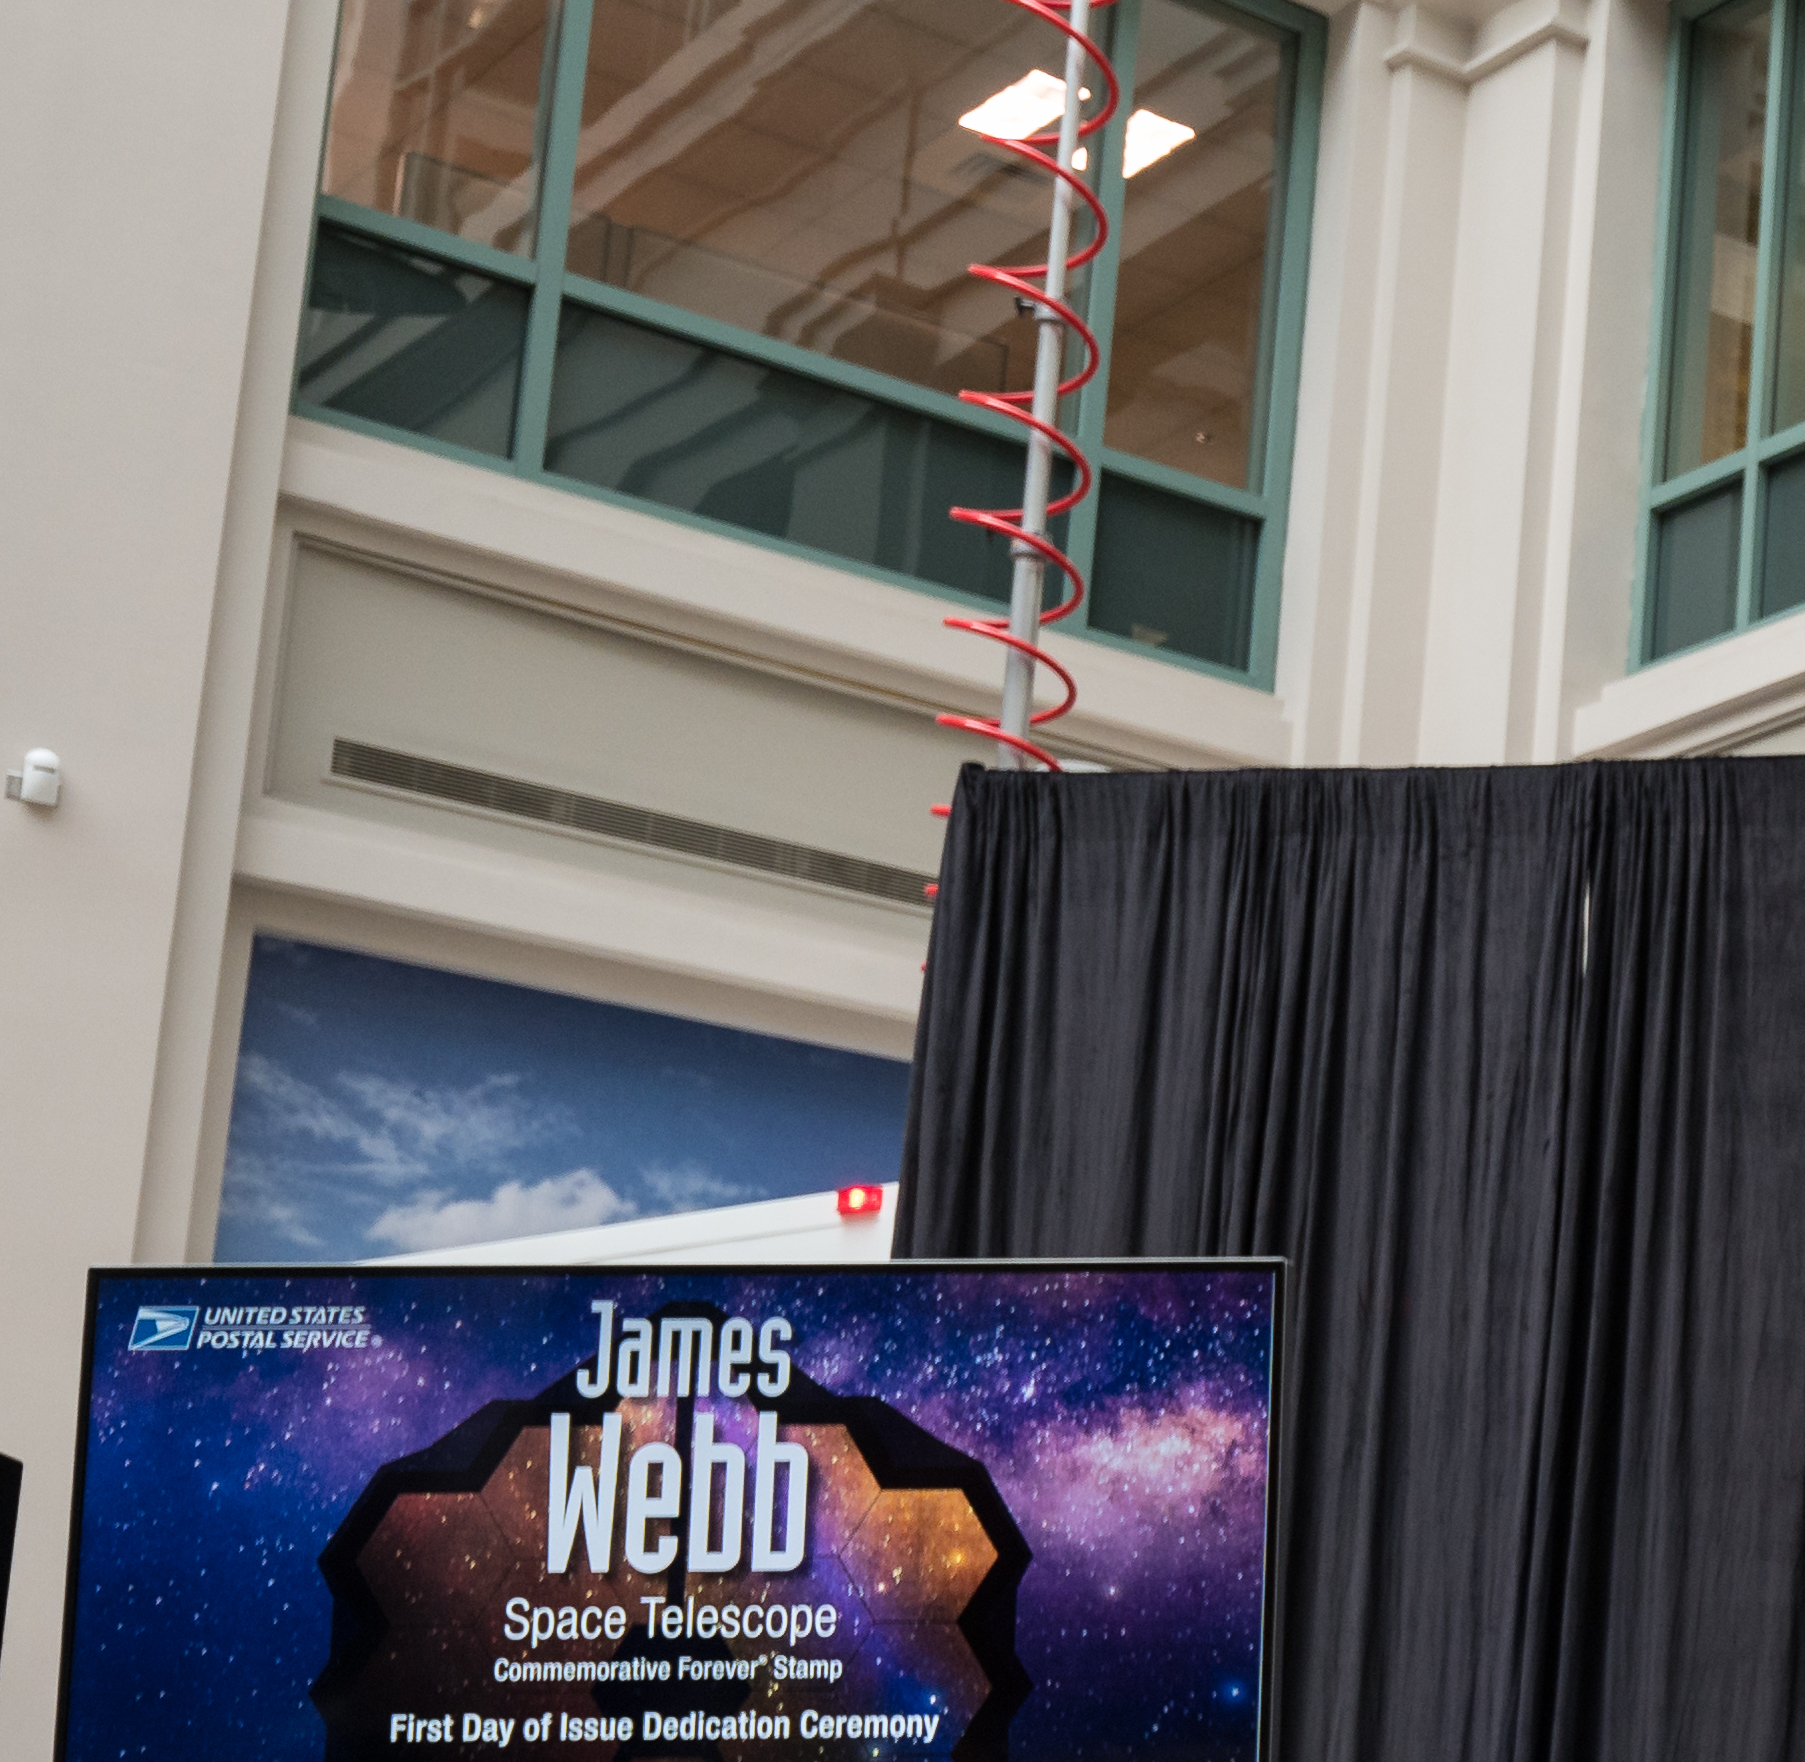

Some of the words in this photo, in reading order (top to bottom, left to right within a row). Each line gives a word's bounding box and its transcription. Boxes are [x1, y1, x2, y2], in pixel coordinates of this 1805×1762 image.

[204, 1307, 288, 1325] UNITED
[289, 1306, 365, 1324] STATES
[197, 1331, 276, 1349] POSTAL
[576, 1299, 793, 1399] James
[547, 1411, 809, 1575] Webb
[503, 1596, 627, 1648] Space
[639, 1595, 838, 1647] Telescope
[493, 1657, 671, 1683] Commemorative
[772, 1654, 844, 1684] Stamp
[390, 1712, 454, 1743] First
[462, 1712, 515, 1748] Day
[522, 1711, 553, 1742] of
[560, 1712, 634, 1742] Issue
[642, 1709, 791, 1742] Dedication
[799, 1709, 941, 1744] Ceremony
